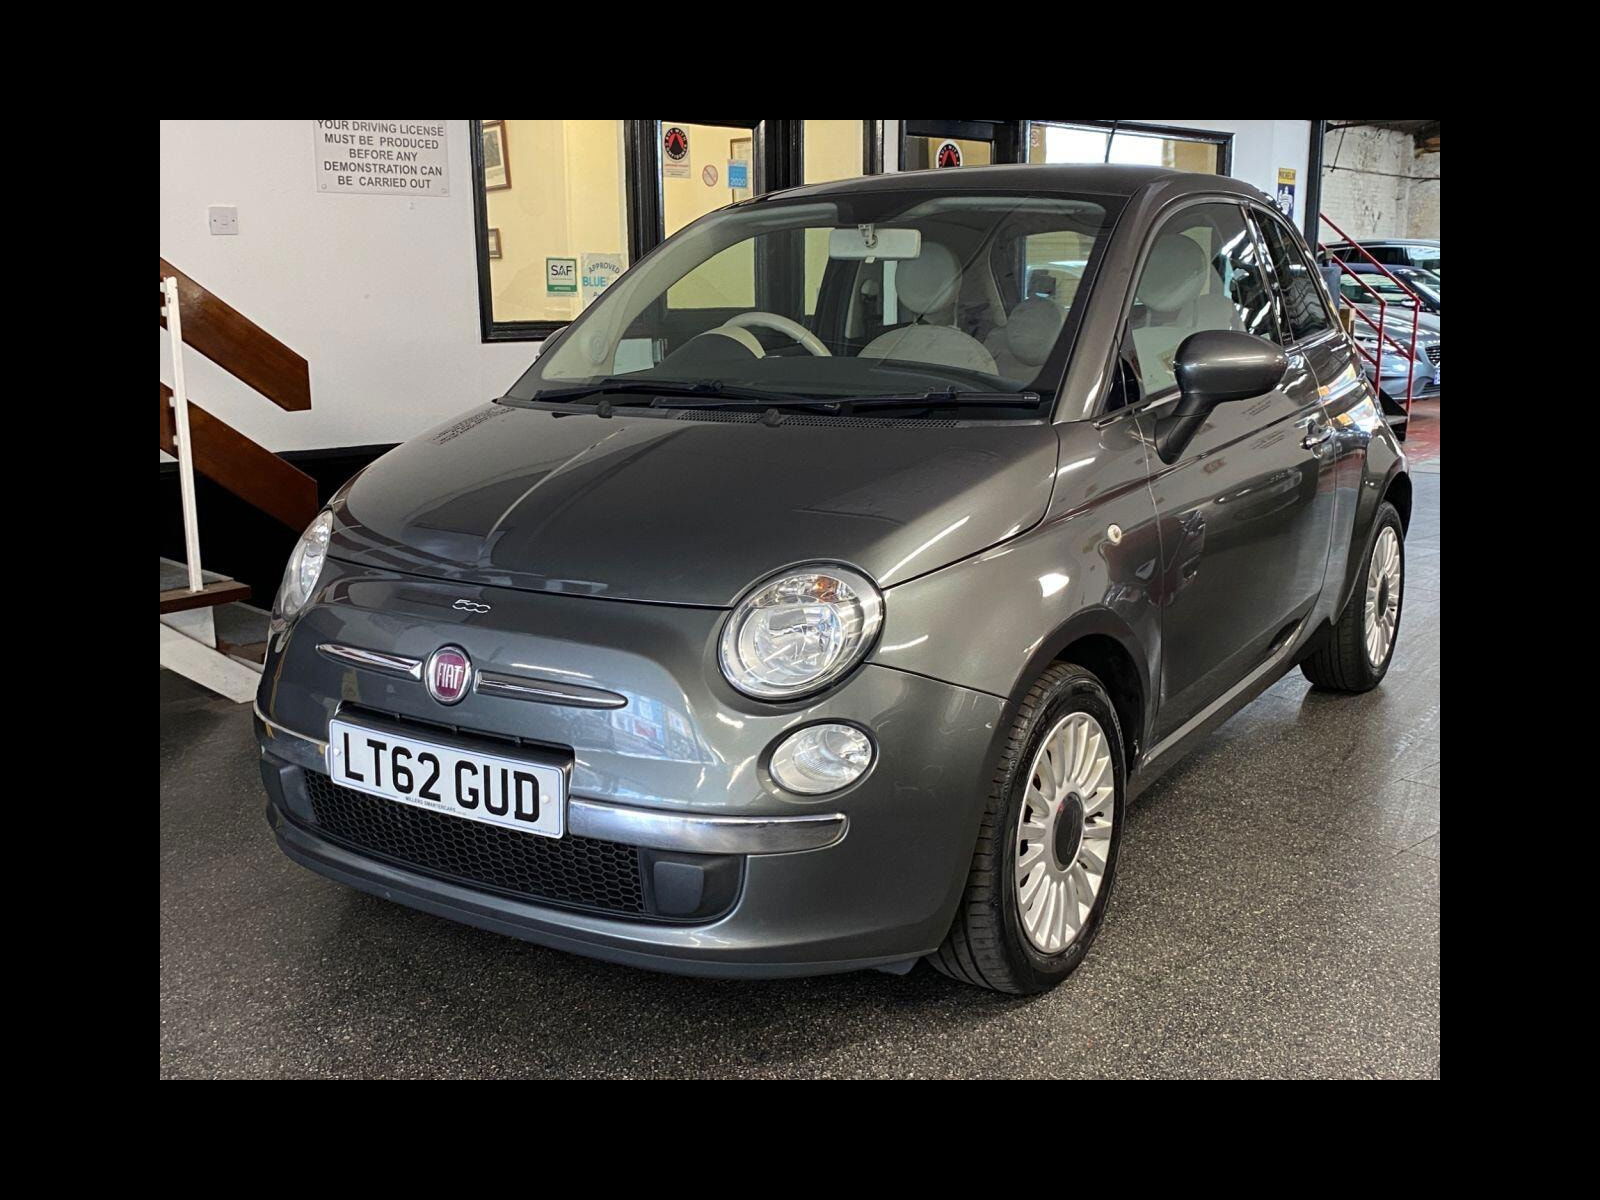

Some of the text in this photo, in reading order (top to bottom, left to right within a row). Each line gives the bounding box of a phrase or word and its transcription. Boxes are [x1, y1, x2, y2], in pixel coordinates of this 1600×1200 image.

[317, 120, 444, 137] YOUR DRIVING LICENSE
[324, 133, 439, 150] MUST BE PRODUCED
[349, 148, 418, 162] BEFORE ANY
[324, 160, 442, 176] DEMONSTRATION CAN
[337, 175, 431, 189] BE CARRIED OUT
[730, 176, 746, 186] 2020
[550, 264, 573, 276] SAF
[588, 262, 620, 274] APPROVED
[452, 599, 491, 613] 500
[436, 662, 464, 689] FIAT
[343, 732, 540, 823] LT62 GUD
